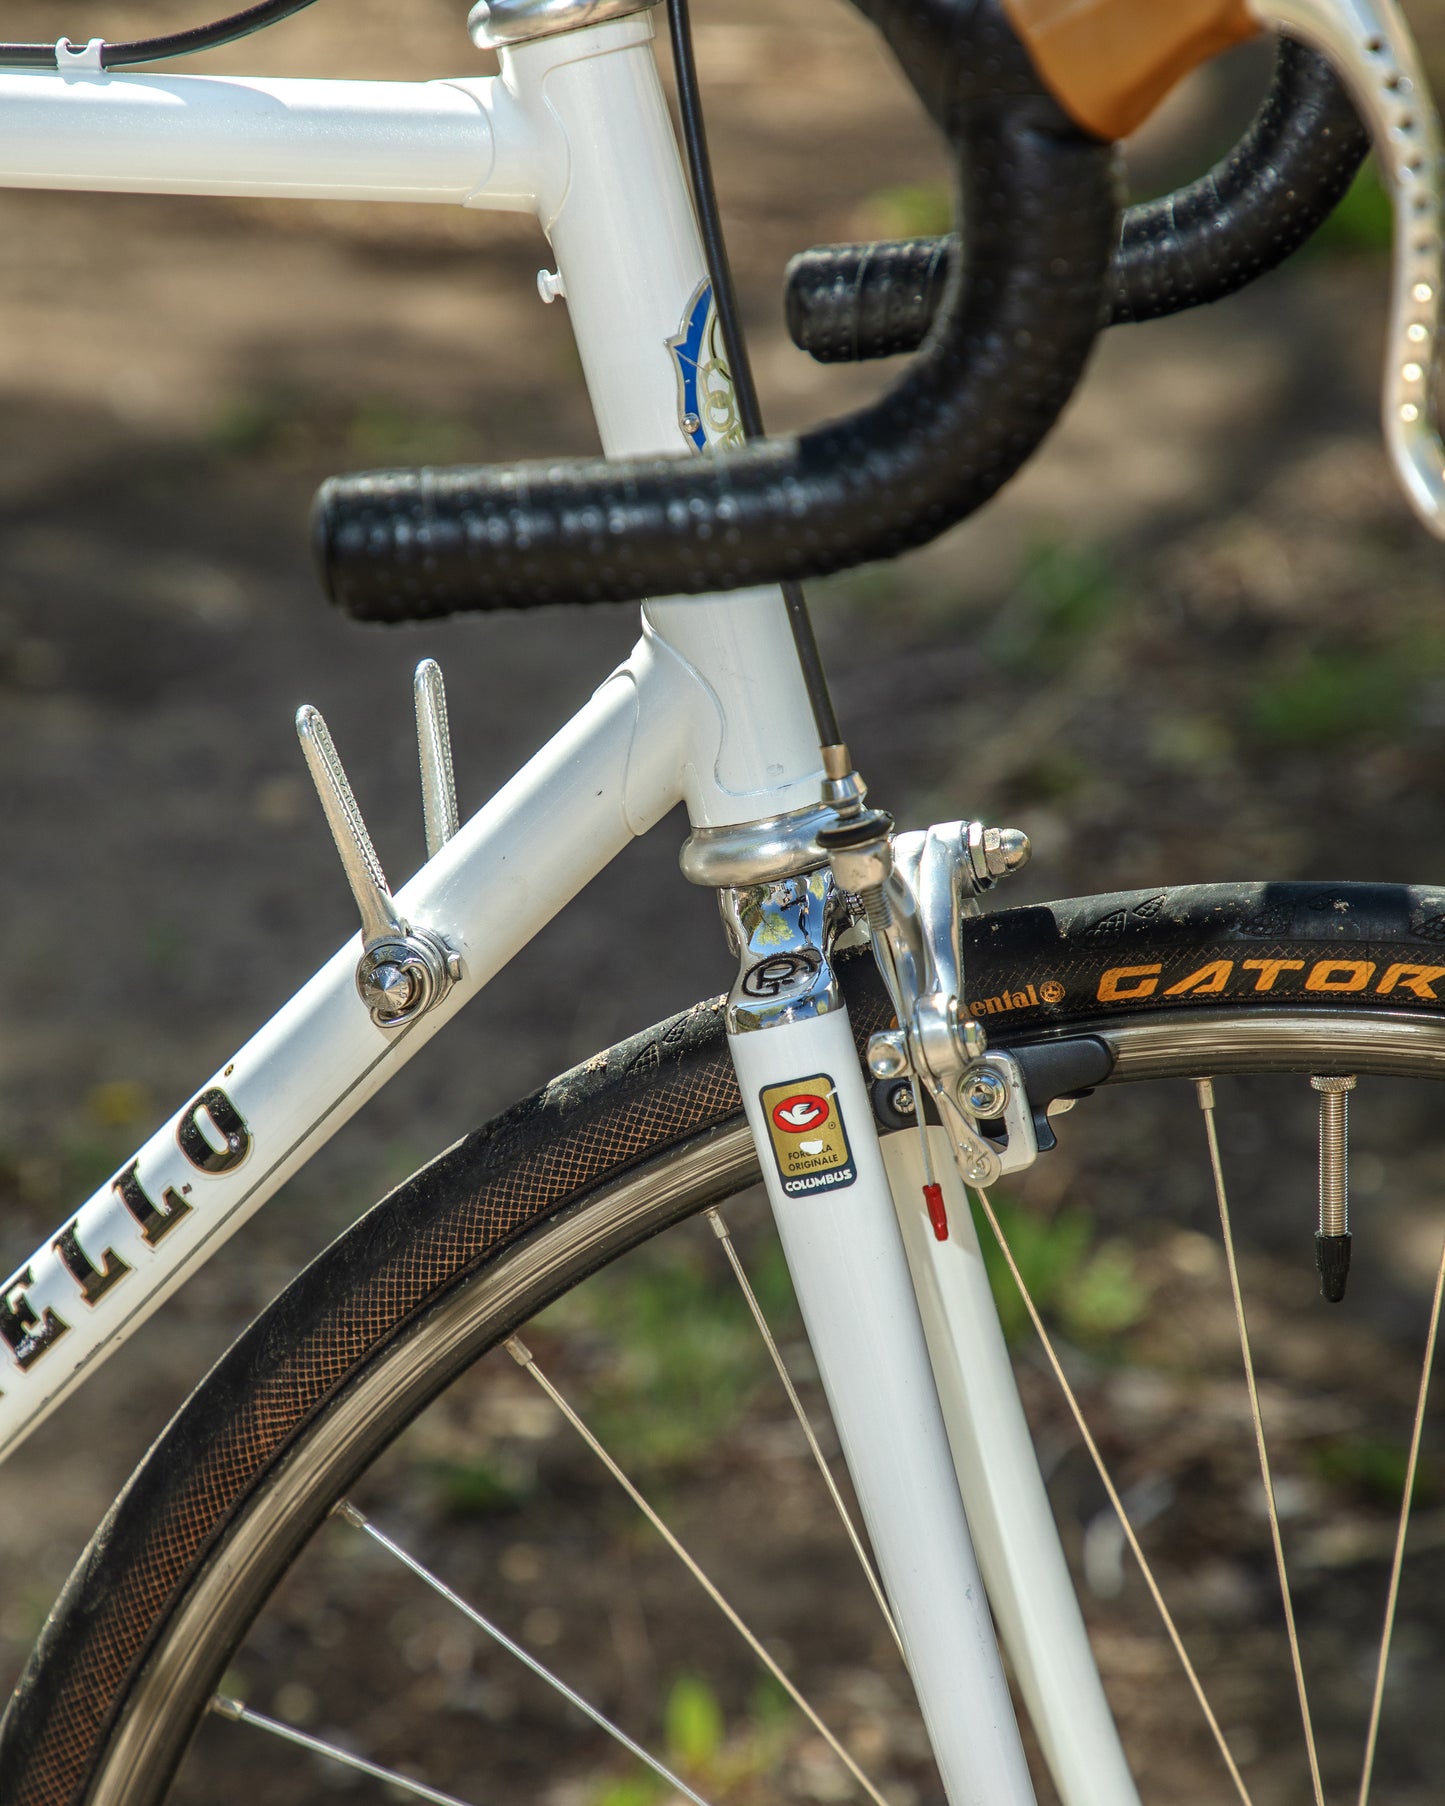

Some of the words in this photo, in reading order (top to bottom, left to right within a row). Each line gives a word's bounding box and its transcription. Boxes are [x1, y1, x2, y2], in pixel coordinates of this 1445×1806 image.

[1097, 959, 1445, 1001] GATOR
[788, 1154, 839, 1171] ORIGINALE
[785, 1169, 853, 1192] COLUMBUS
[0, 1087, 252, 1374] ELLO
